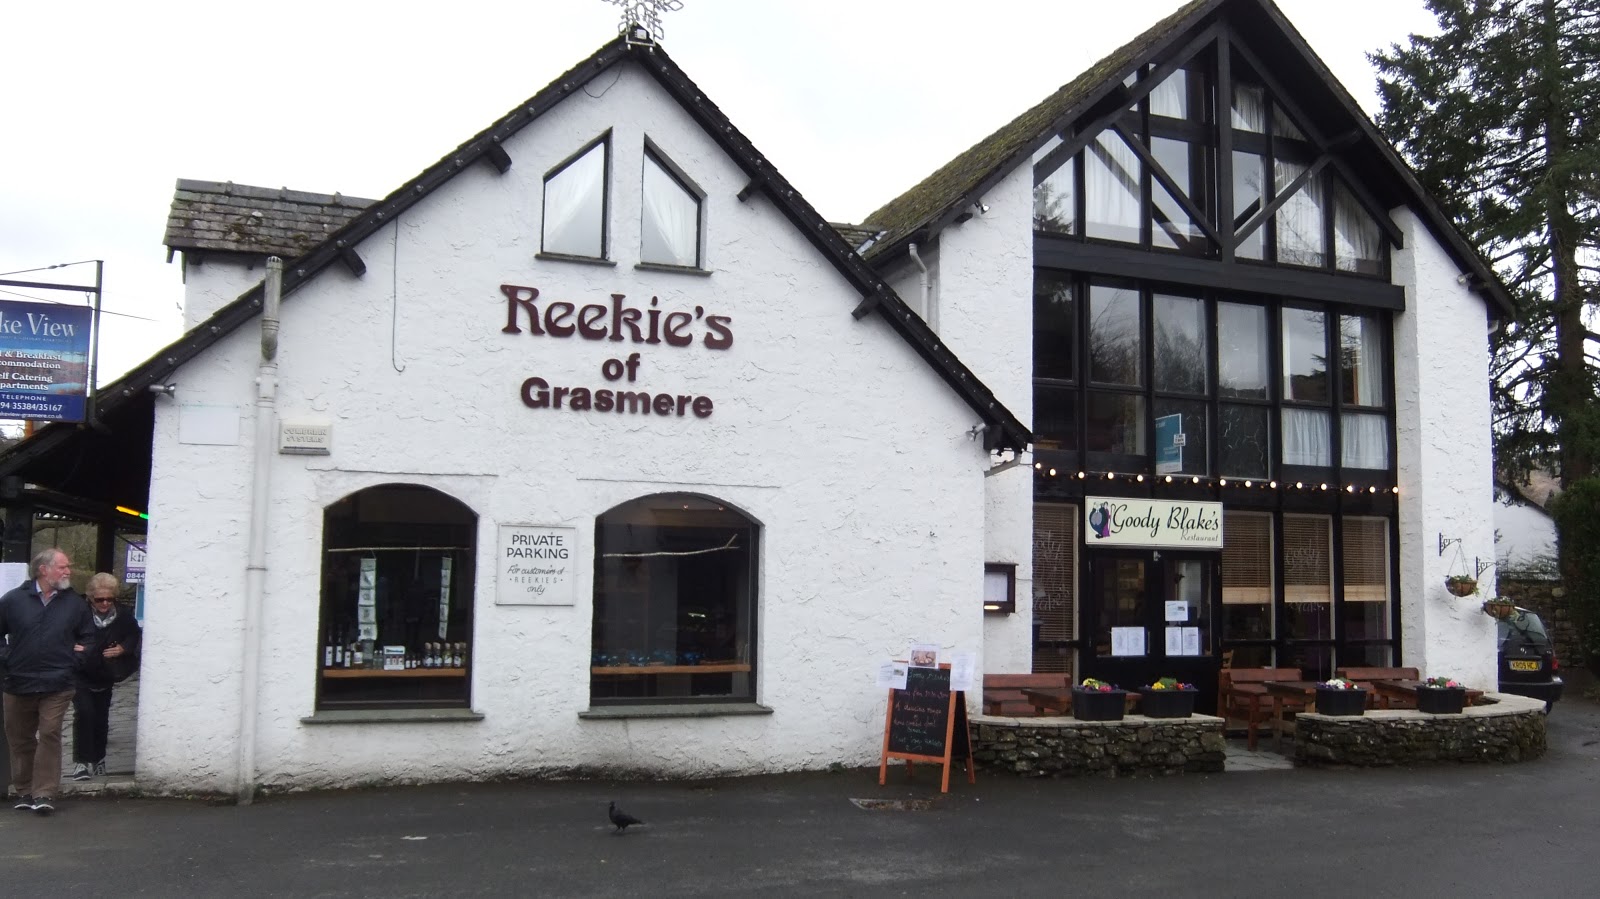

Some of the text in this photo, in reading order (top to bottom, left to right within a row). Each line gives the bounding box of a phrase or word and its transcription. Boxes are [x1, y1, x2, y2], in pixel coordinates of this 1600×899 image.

[500, 284, 734, 350] Reekie's
[26, 312, 75, 337] View
[16, 350, 62, 361] Breakfast
[0, 360, 61, 369] ommodation
[602, 353, 641, 382] of
[12, 372, 53, 383] Catering
[2, 393, 47, 401] TELEPHONE
[520, 377, 714, 418] Grasmere
[12, 402, 63, 412] 35384/35167
[286, 435, 323, 443] SYSTEMS
[1111, 503, 1219, 538] Goody Blake's
[512, 534, 563, 546] PRIVATE
[1181, 529, 1219, 542] Restaurant
[507, 547, 569, 559] PARKING
[507, 565, 520, 574] For
[514, 576, 557, 584] REEKIES
[526, 585, 545, 596] only
